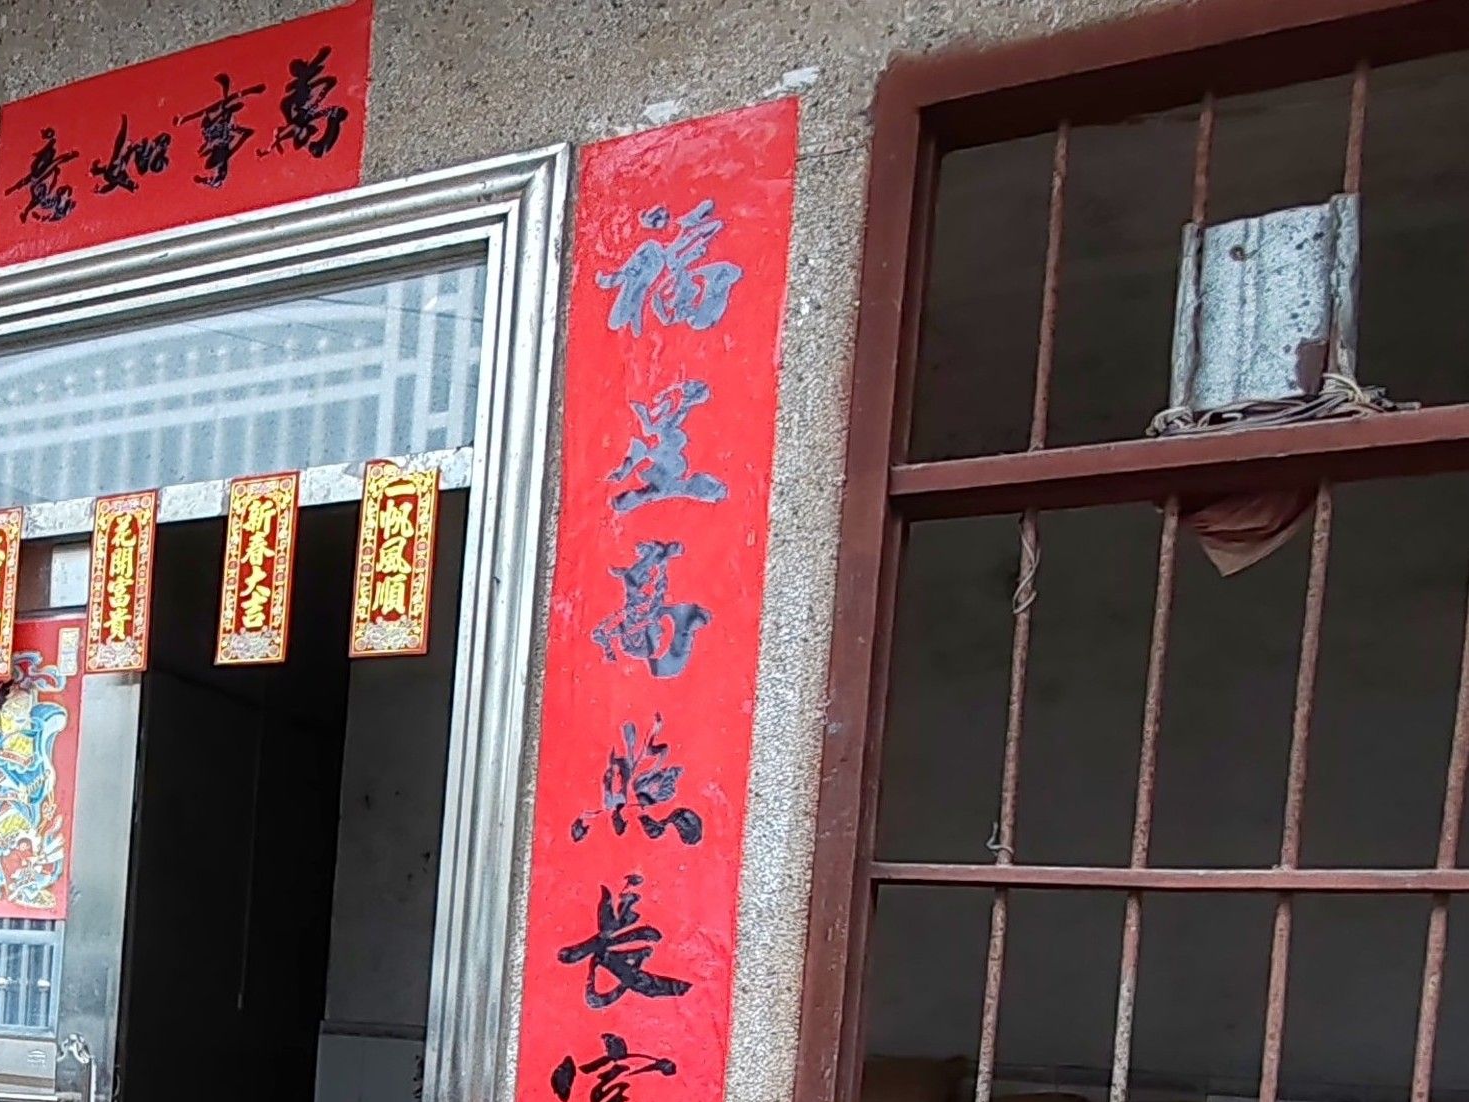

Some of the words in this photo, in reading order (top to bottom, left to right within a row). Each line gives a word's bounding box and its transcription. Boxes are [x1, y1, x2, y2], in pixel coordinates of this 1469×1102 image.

[103, 512, 138, 640] 花開富貴
[240, 499, 277, 629] 新春大吉
[372, 483, 415, 615] 一帆風順
